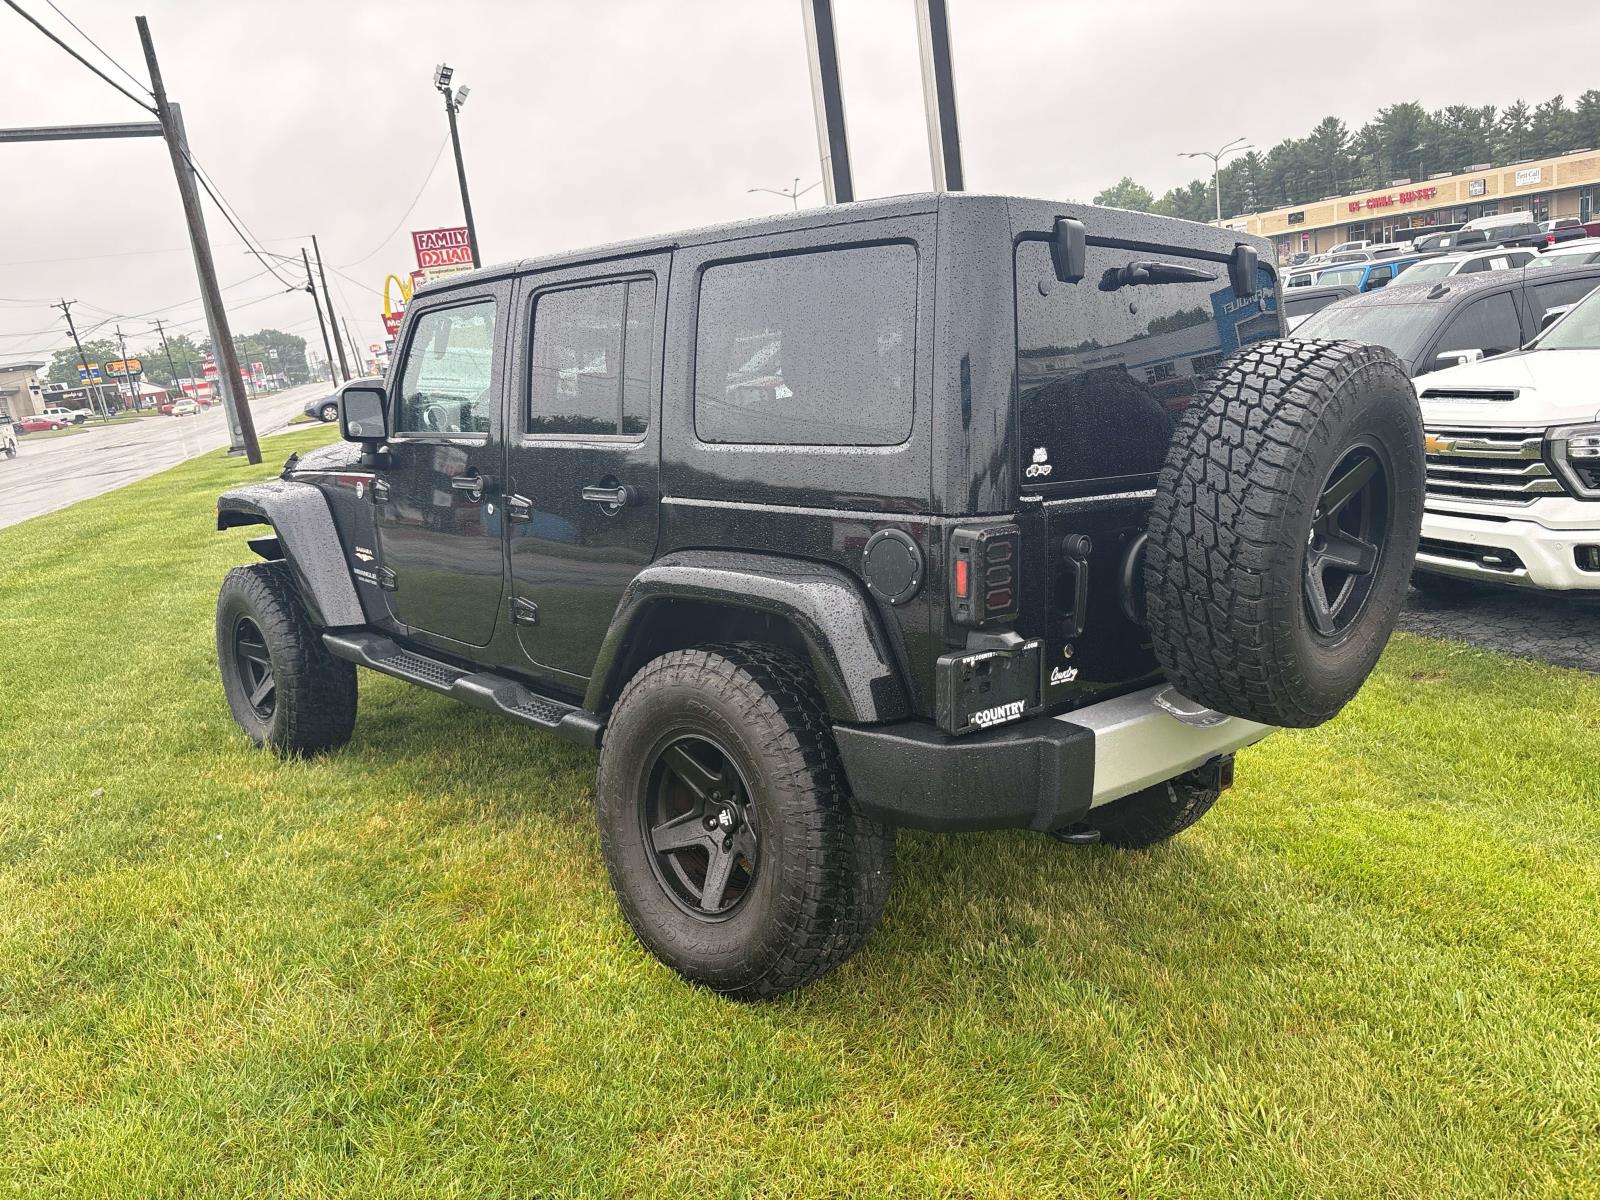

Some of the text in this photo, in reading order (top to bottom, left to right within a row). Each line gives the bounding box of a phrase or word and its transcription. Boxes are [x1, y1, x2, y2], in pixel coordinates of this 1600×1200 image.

[1399, 186, 1437, 204] BUFFET
[416, 230, 468, 250] FAMILY
[420, 246, 473, 267] DOLLAR
[1050, 666, 1078, 681] Country
[975, 699, 1025, 725] COUNTRY
